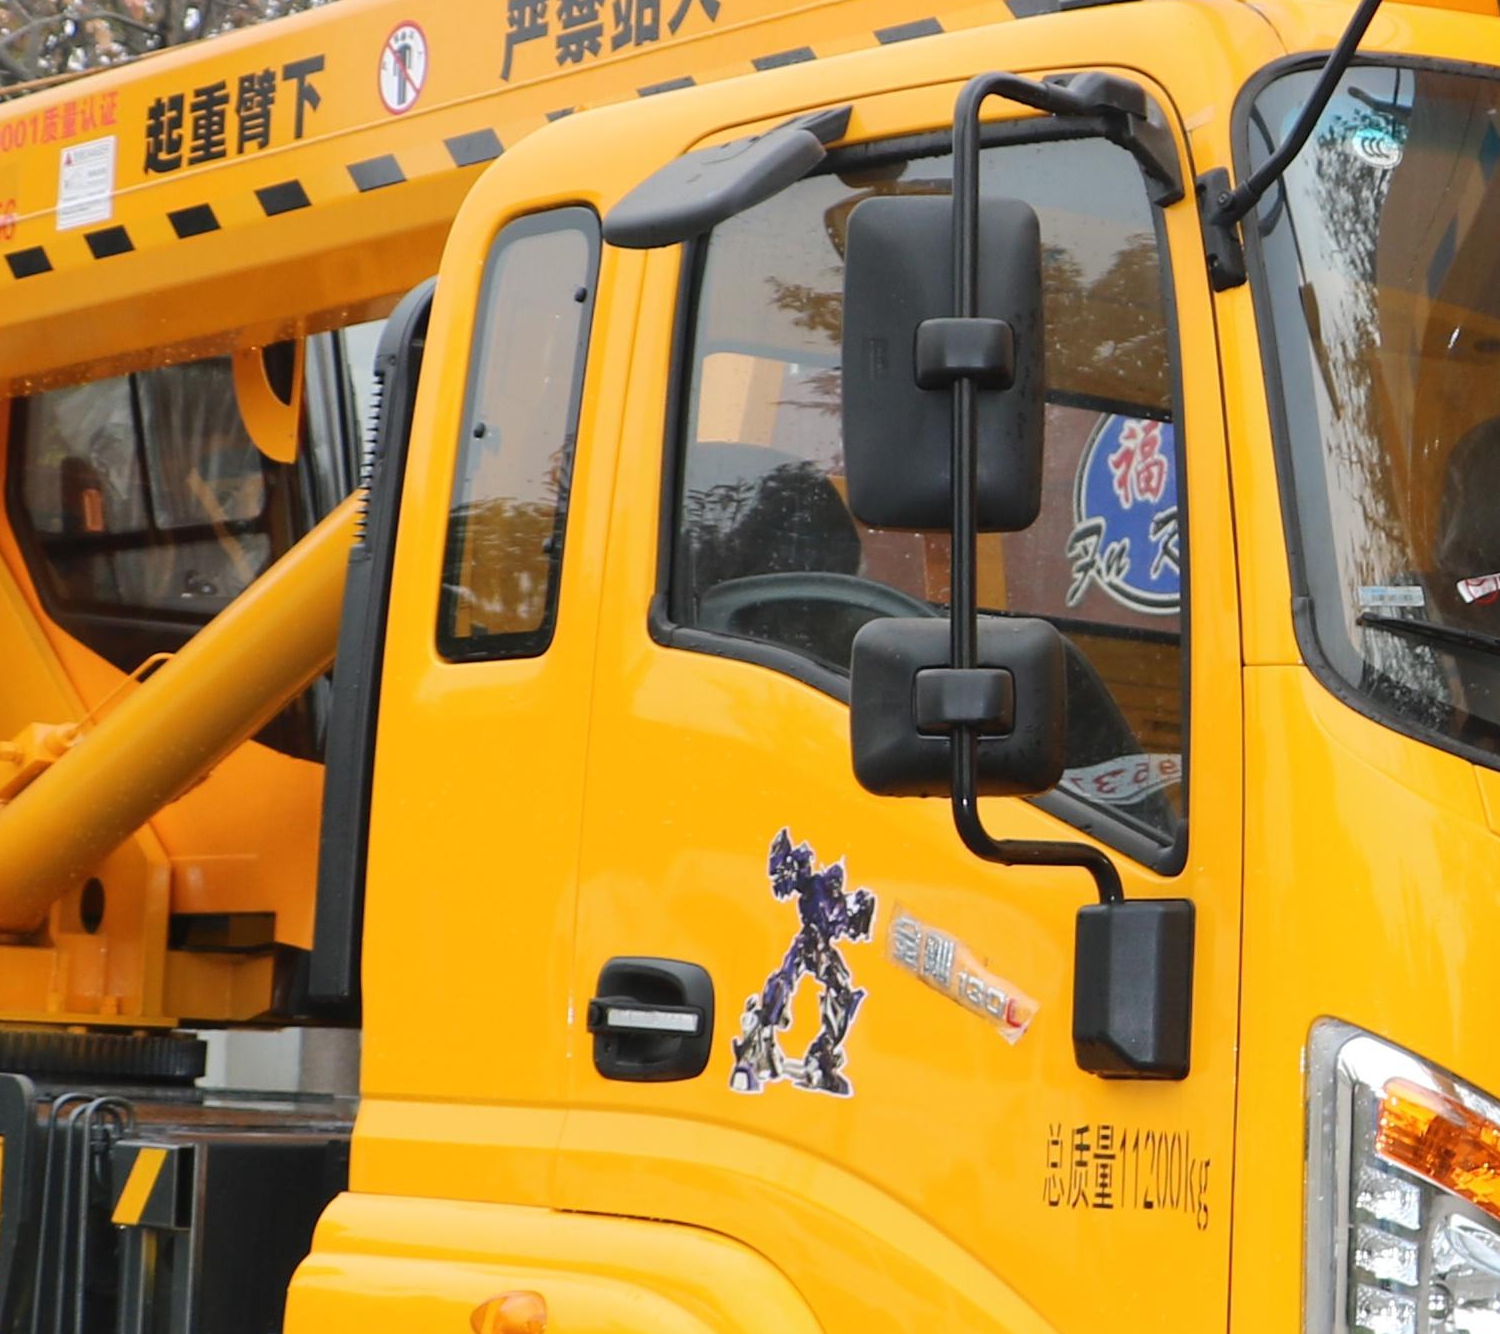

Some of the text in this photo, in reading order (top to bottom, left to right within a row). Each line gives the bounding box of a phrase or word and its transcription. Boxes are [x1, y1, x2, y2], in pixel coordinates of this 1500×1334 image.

[143, 53, 325, 175] 起重臂下
[1043, 1123, 1211, 1231] 总质量11200kg
